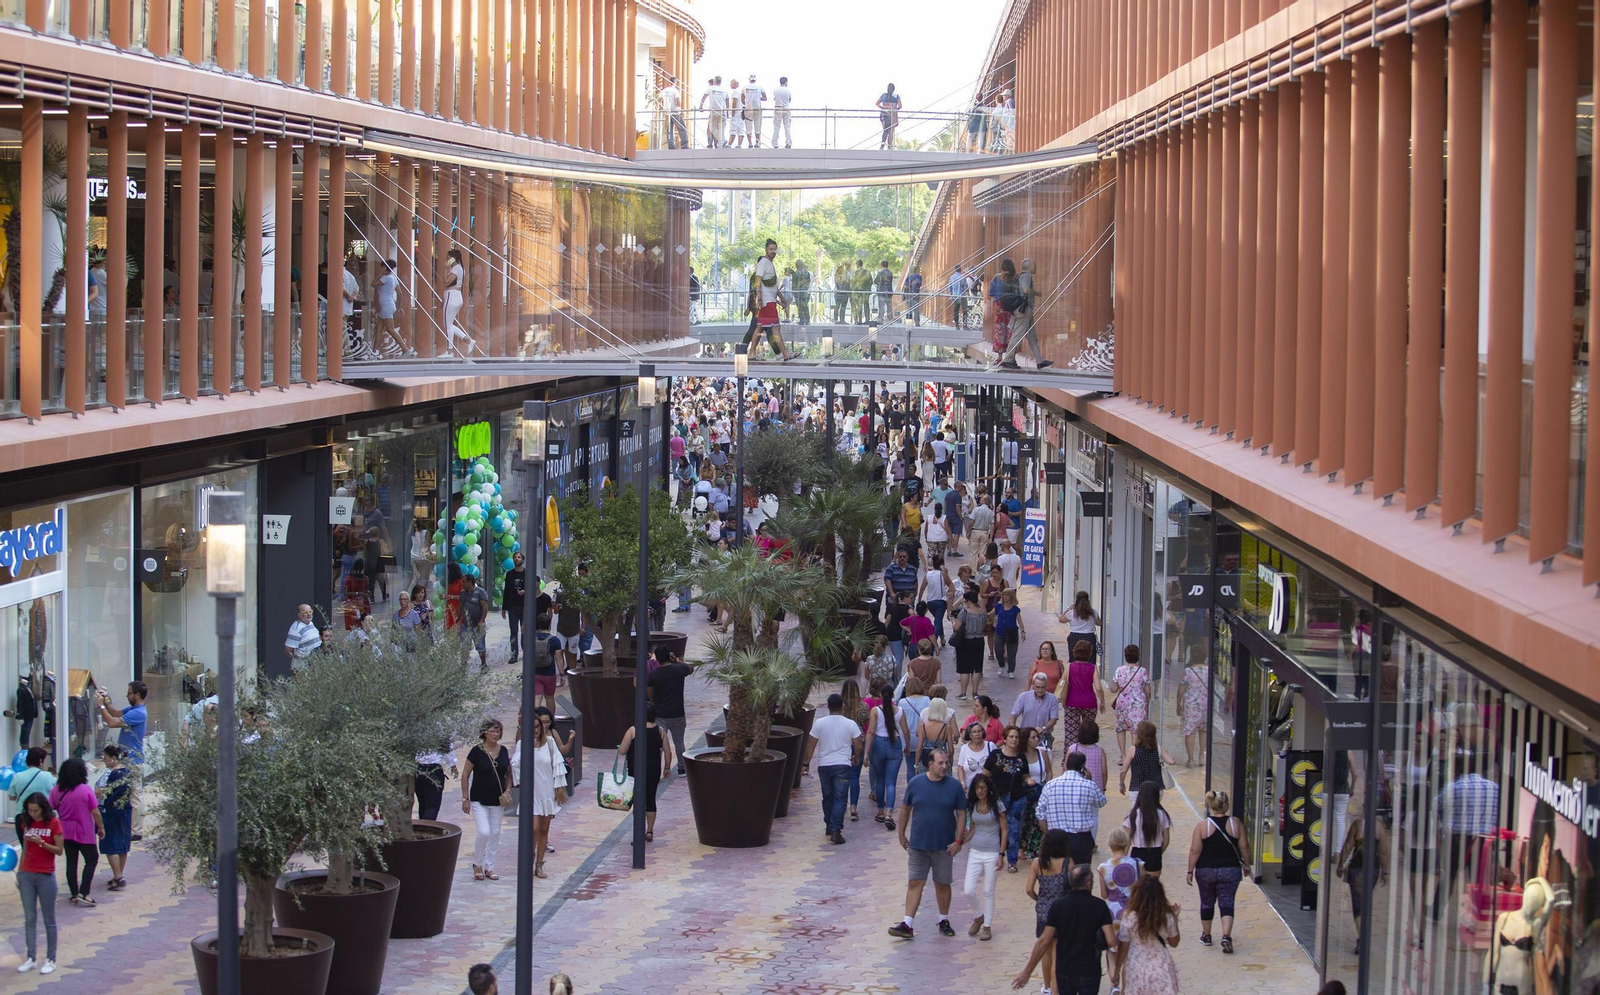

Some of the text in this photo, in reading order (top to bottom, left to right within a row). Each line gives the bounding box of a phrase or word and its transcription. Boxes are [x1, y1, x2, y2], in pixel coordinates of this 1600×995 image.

[1024, 523, 1045, 544] 20
[1031, 545, 1044, 554] GAFAS
[1025, 553, 1041, 562] DE SOL
[1188, 585, 1204, 596] JD
